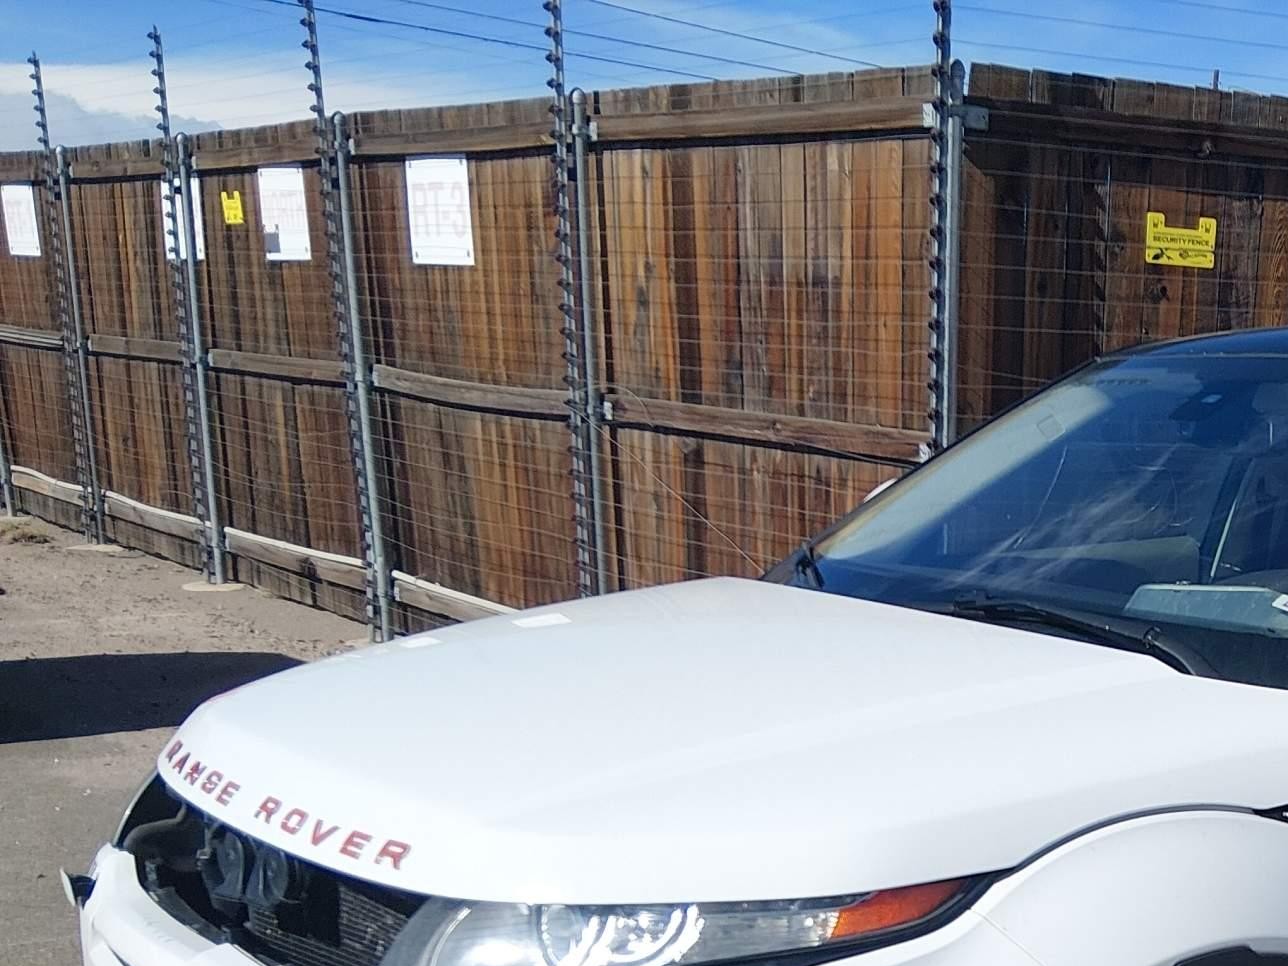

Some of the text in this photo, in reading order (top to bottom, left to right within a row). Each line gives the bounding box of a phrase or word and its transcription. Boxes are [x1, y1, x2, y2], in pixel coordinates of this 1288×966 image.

[1153, 235, 1210, 247] SECURITY FENCE
[165, 739, 412, 870] RANGE ROVER
